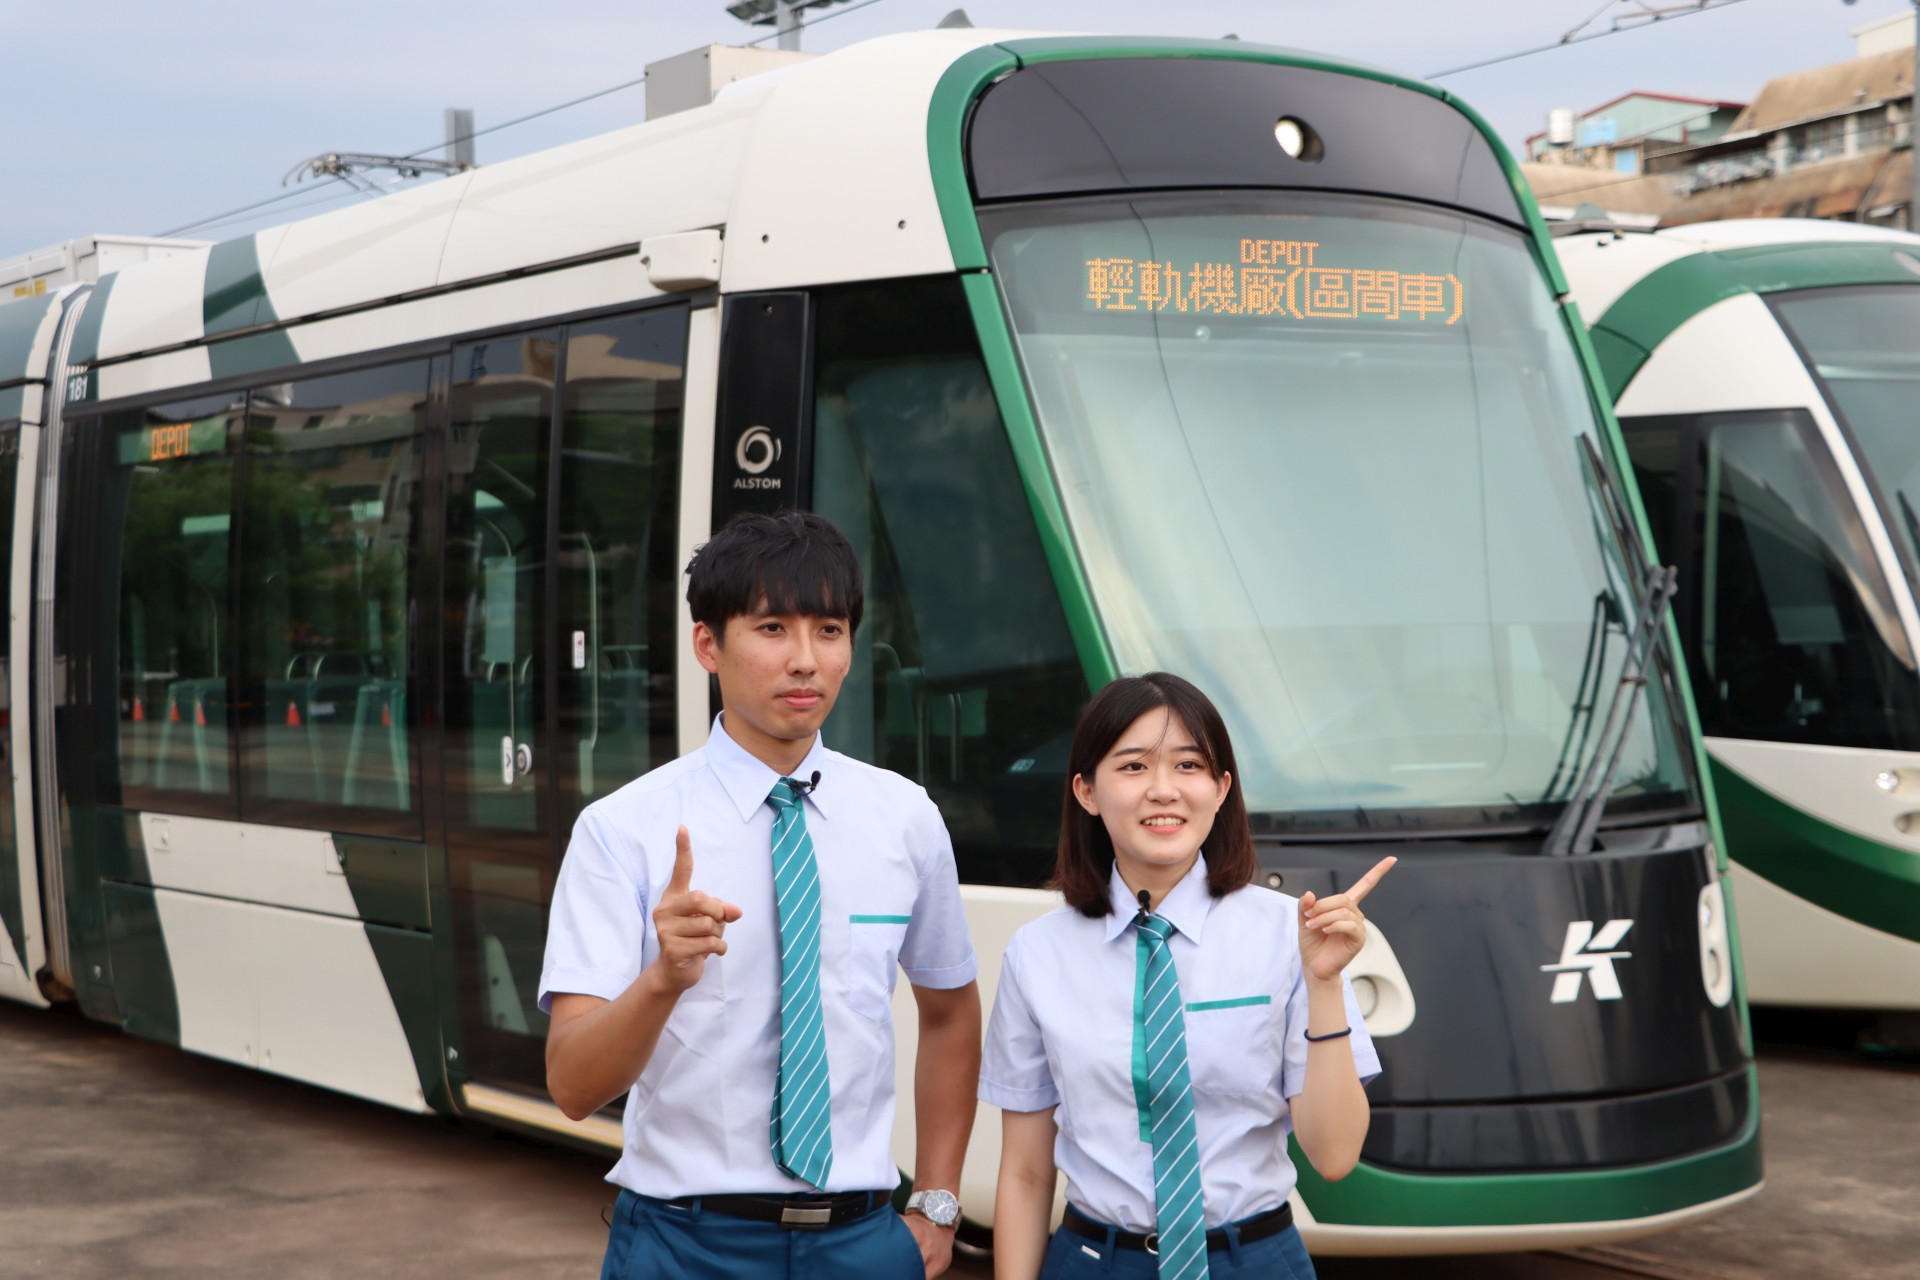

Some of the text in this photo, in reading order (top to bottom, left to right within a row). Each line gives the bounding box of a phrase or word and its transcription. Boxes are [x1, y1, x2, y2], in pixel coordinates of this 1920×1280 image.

[1240, 239, 1319, 266] DEPOT
[1086, 257, 1463, 325] 輕軌機廠(區間車)
[70, 376, 88, 401] 181
[151, 422, 192, 461] DEPOT
[734, 477, 782, 489] ALSTOM
